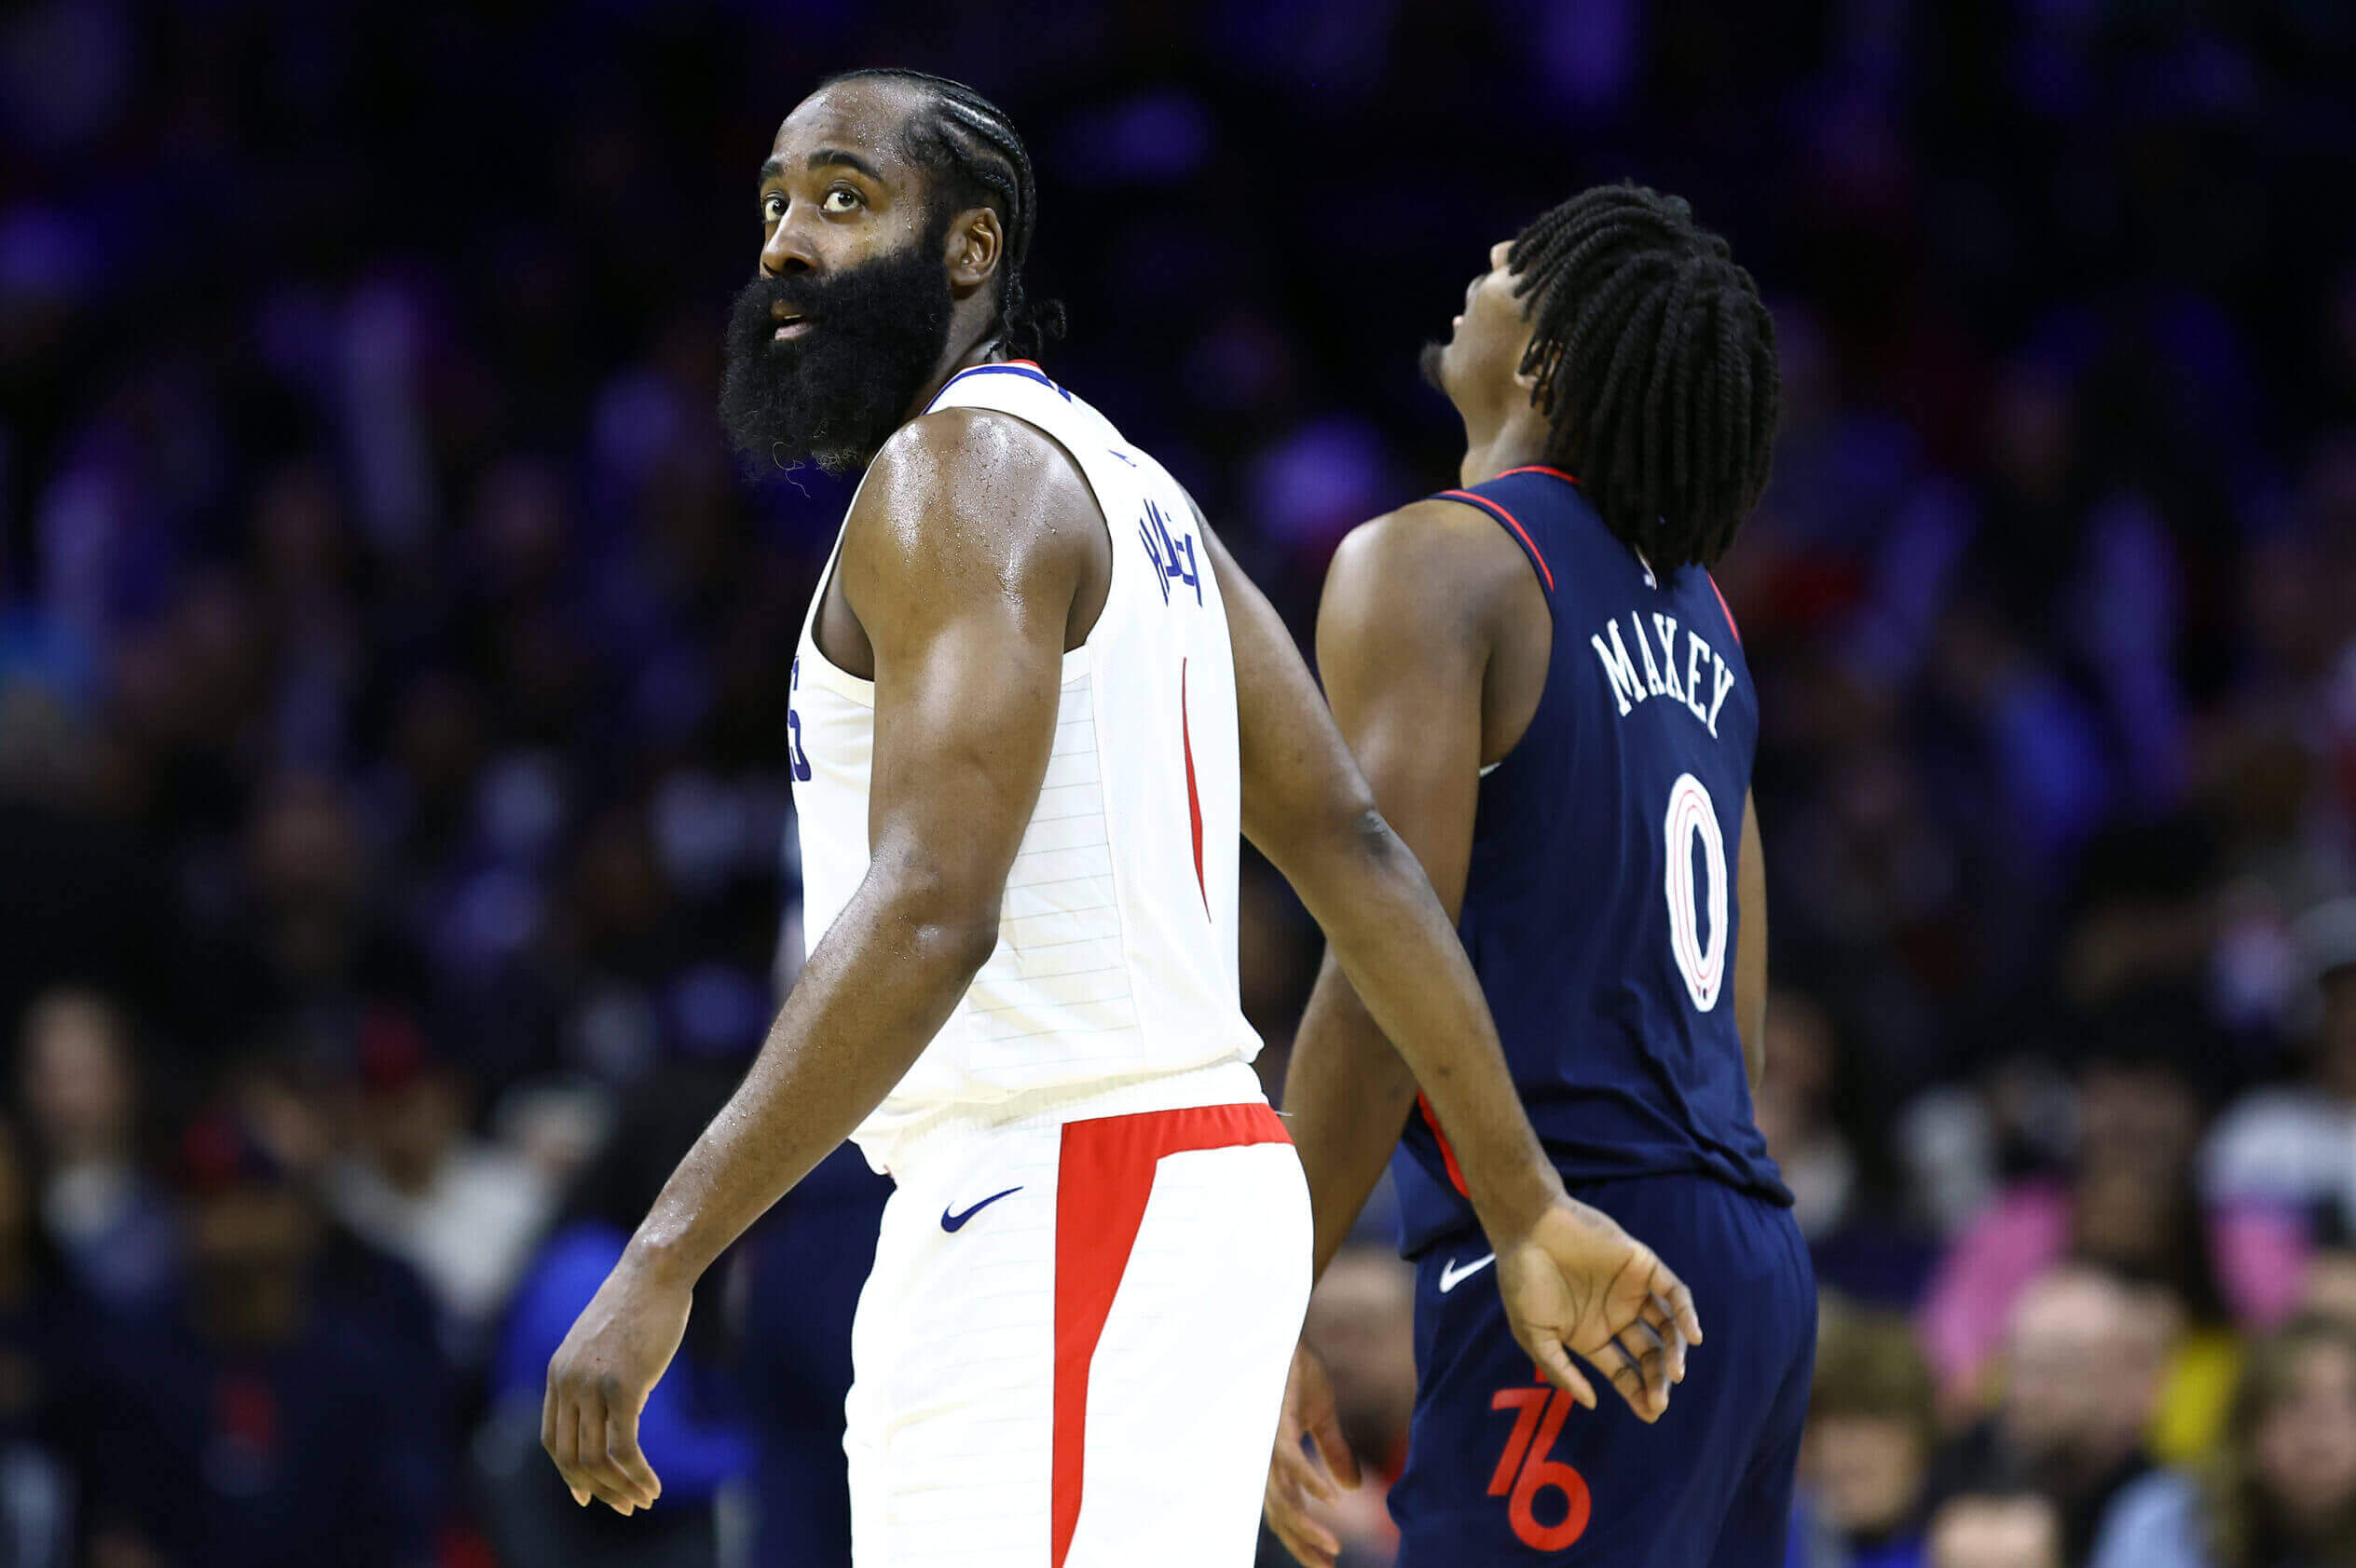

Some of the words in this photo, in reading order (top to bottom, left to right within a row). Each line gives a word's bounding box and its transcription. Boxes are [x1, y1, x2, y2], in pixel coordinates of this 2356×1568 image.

[1591, 610, 1735, 740] MAXEY
[1664, 772, 1729, 1013] 0
[1486, 1386, 1592, 1552] 76
